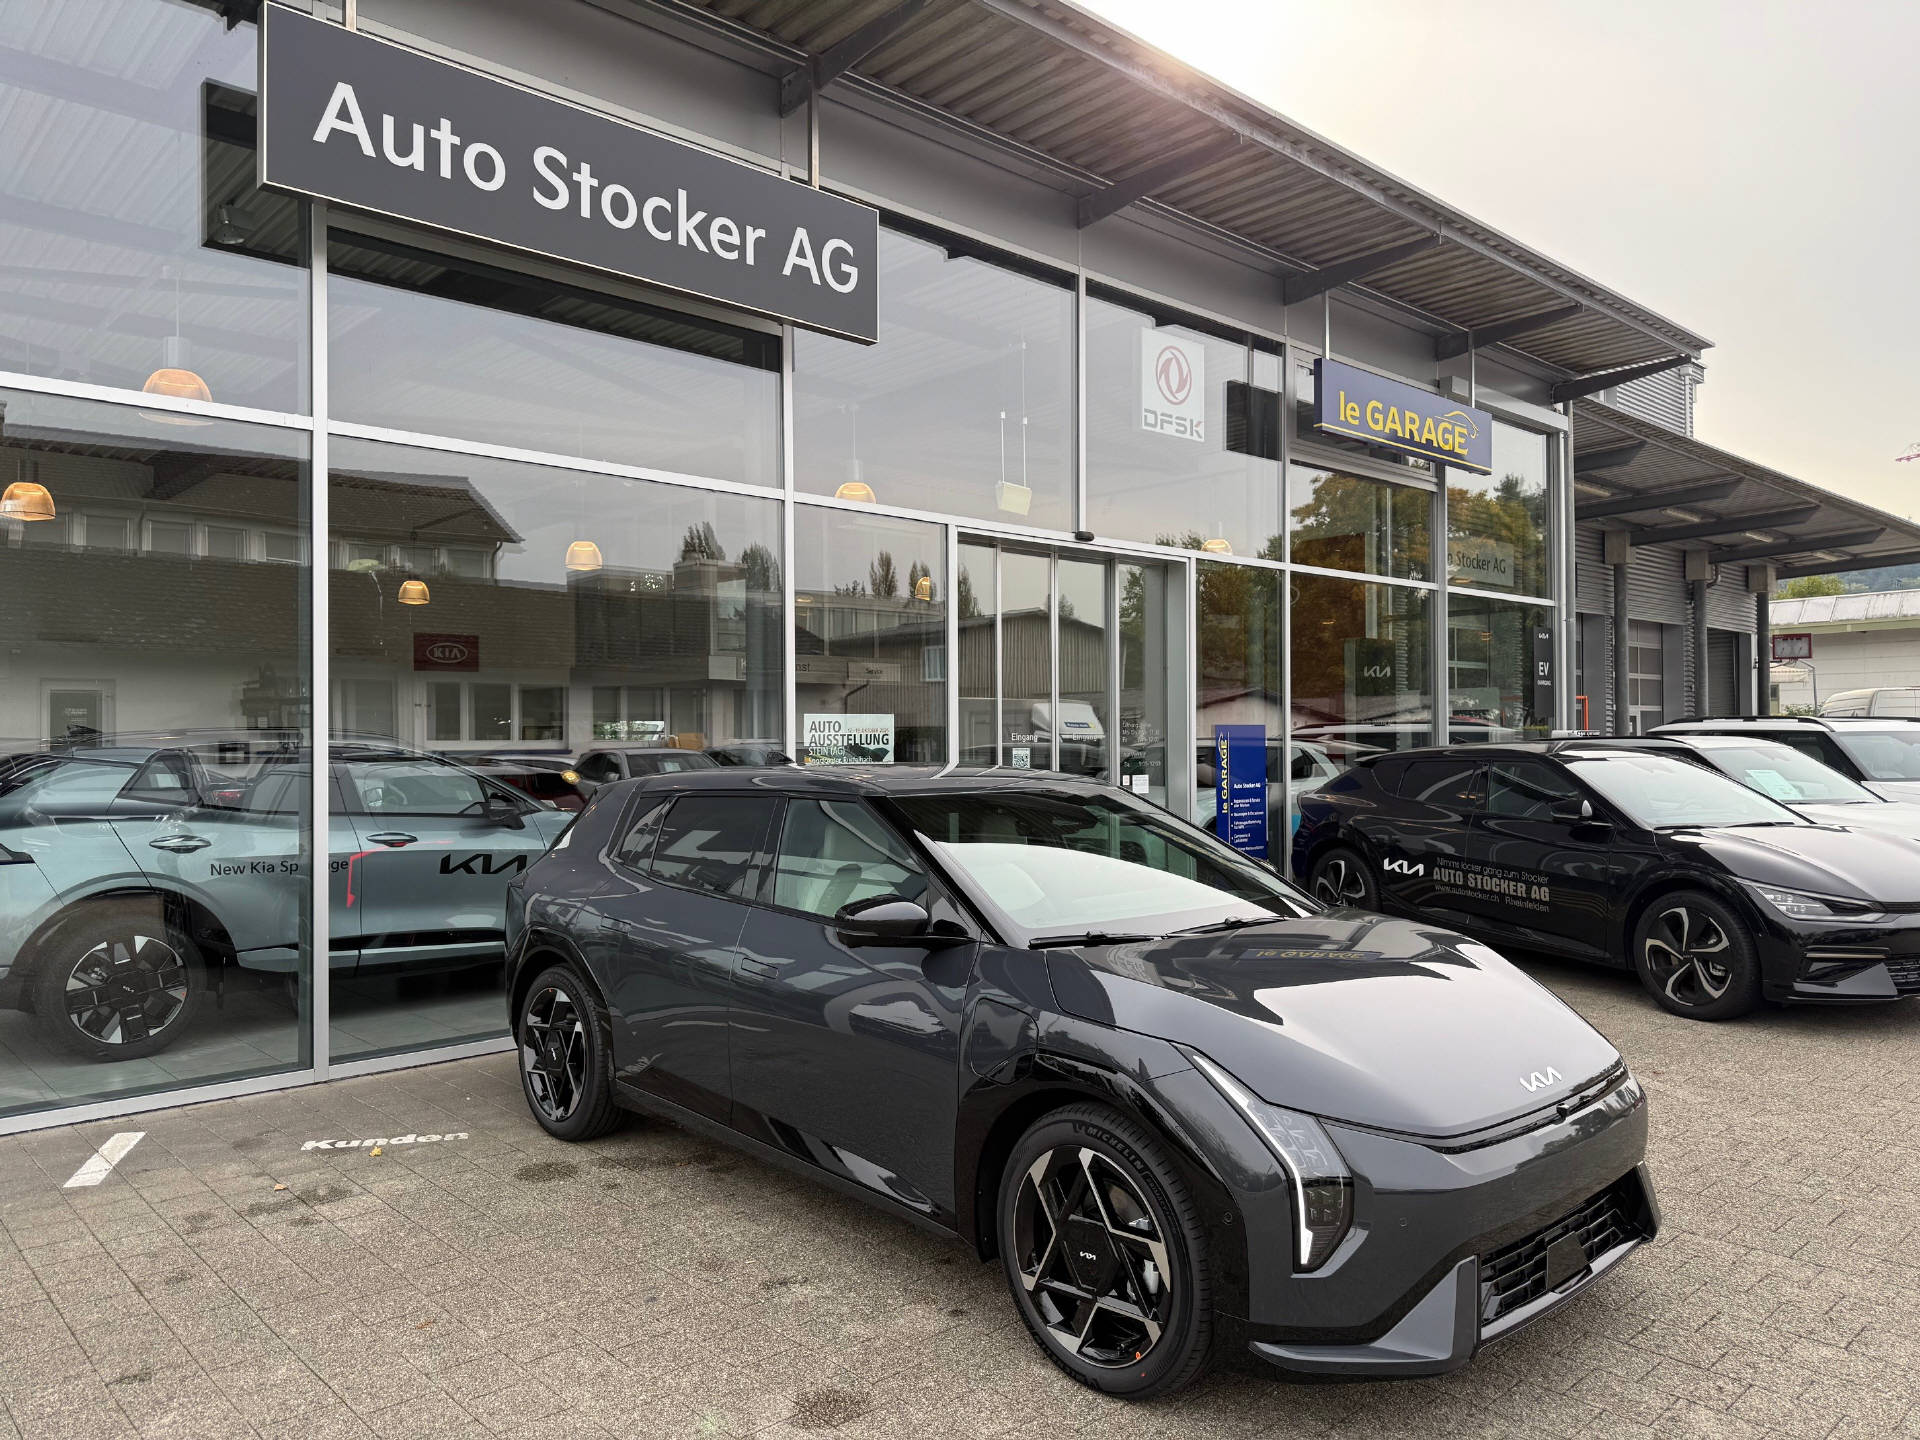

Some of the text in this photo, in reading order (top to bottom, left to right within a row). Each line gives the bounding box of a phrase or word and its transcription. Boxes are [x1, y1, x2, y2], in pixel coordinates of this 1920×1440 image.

[312, 81, 859, 294] Auto Stocker AG
[1143, 407, 1203, 439] DFSK
[1339, 390, 1469, 457] le GARAGE
[1456, 551, 1490, 571] Stocker
[1493, 557, 1506, 574] AG
[433, 647, 461, 659] KIA
[1363, 665, 1391, 678] KIA
[1538, 661, 1549, 676] EV
[809, 720, 842, 734] AUTO
[808, 733, 890, 747] AUSSTELLUNG
[1011, 732, 1038, 743] Eingang
[808, 746, 829, 756] STEIN
[210, 863, 246, 876] New
[250, 861, 275, 874] Kia
[1383, 857, 1425, 877] KIA
[1433, 867, 1550, 902] AUTO STOCKER AG
[1521, 871, 1550, 885] Stocker
[1519, 1066, 1562, 1092] KIA
[301, 1132, 469, 1150] Kunden
[1087, 1126, 1144, 1171] MICHELIN
